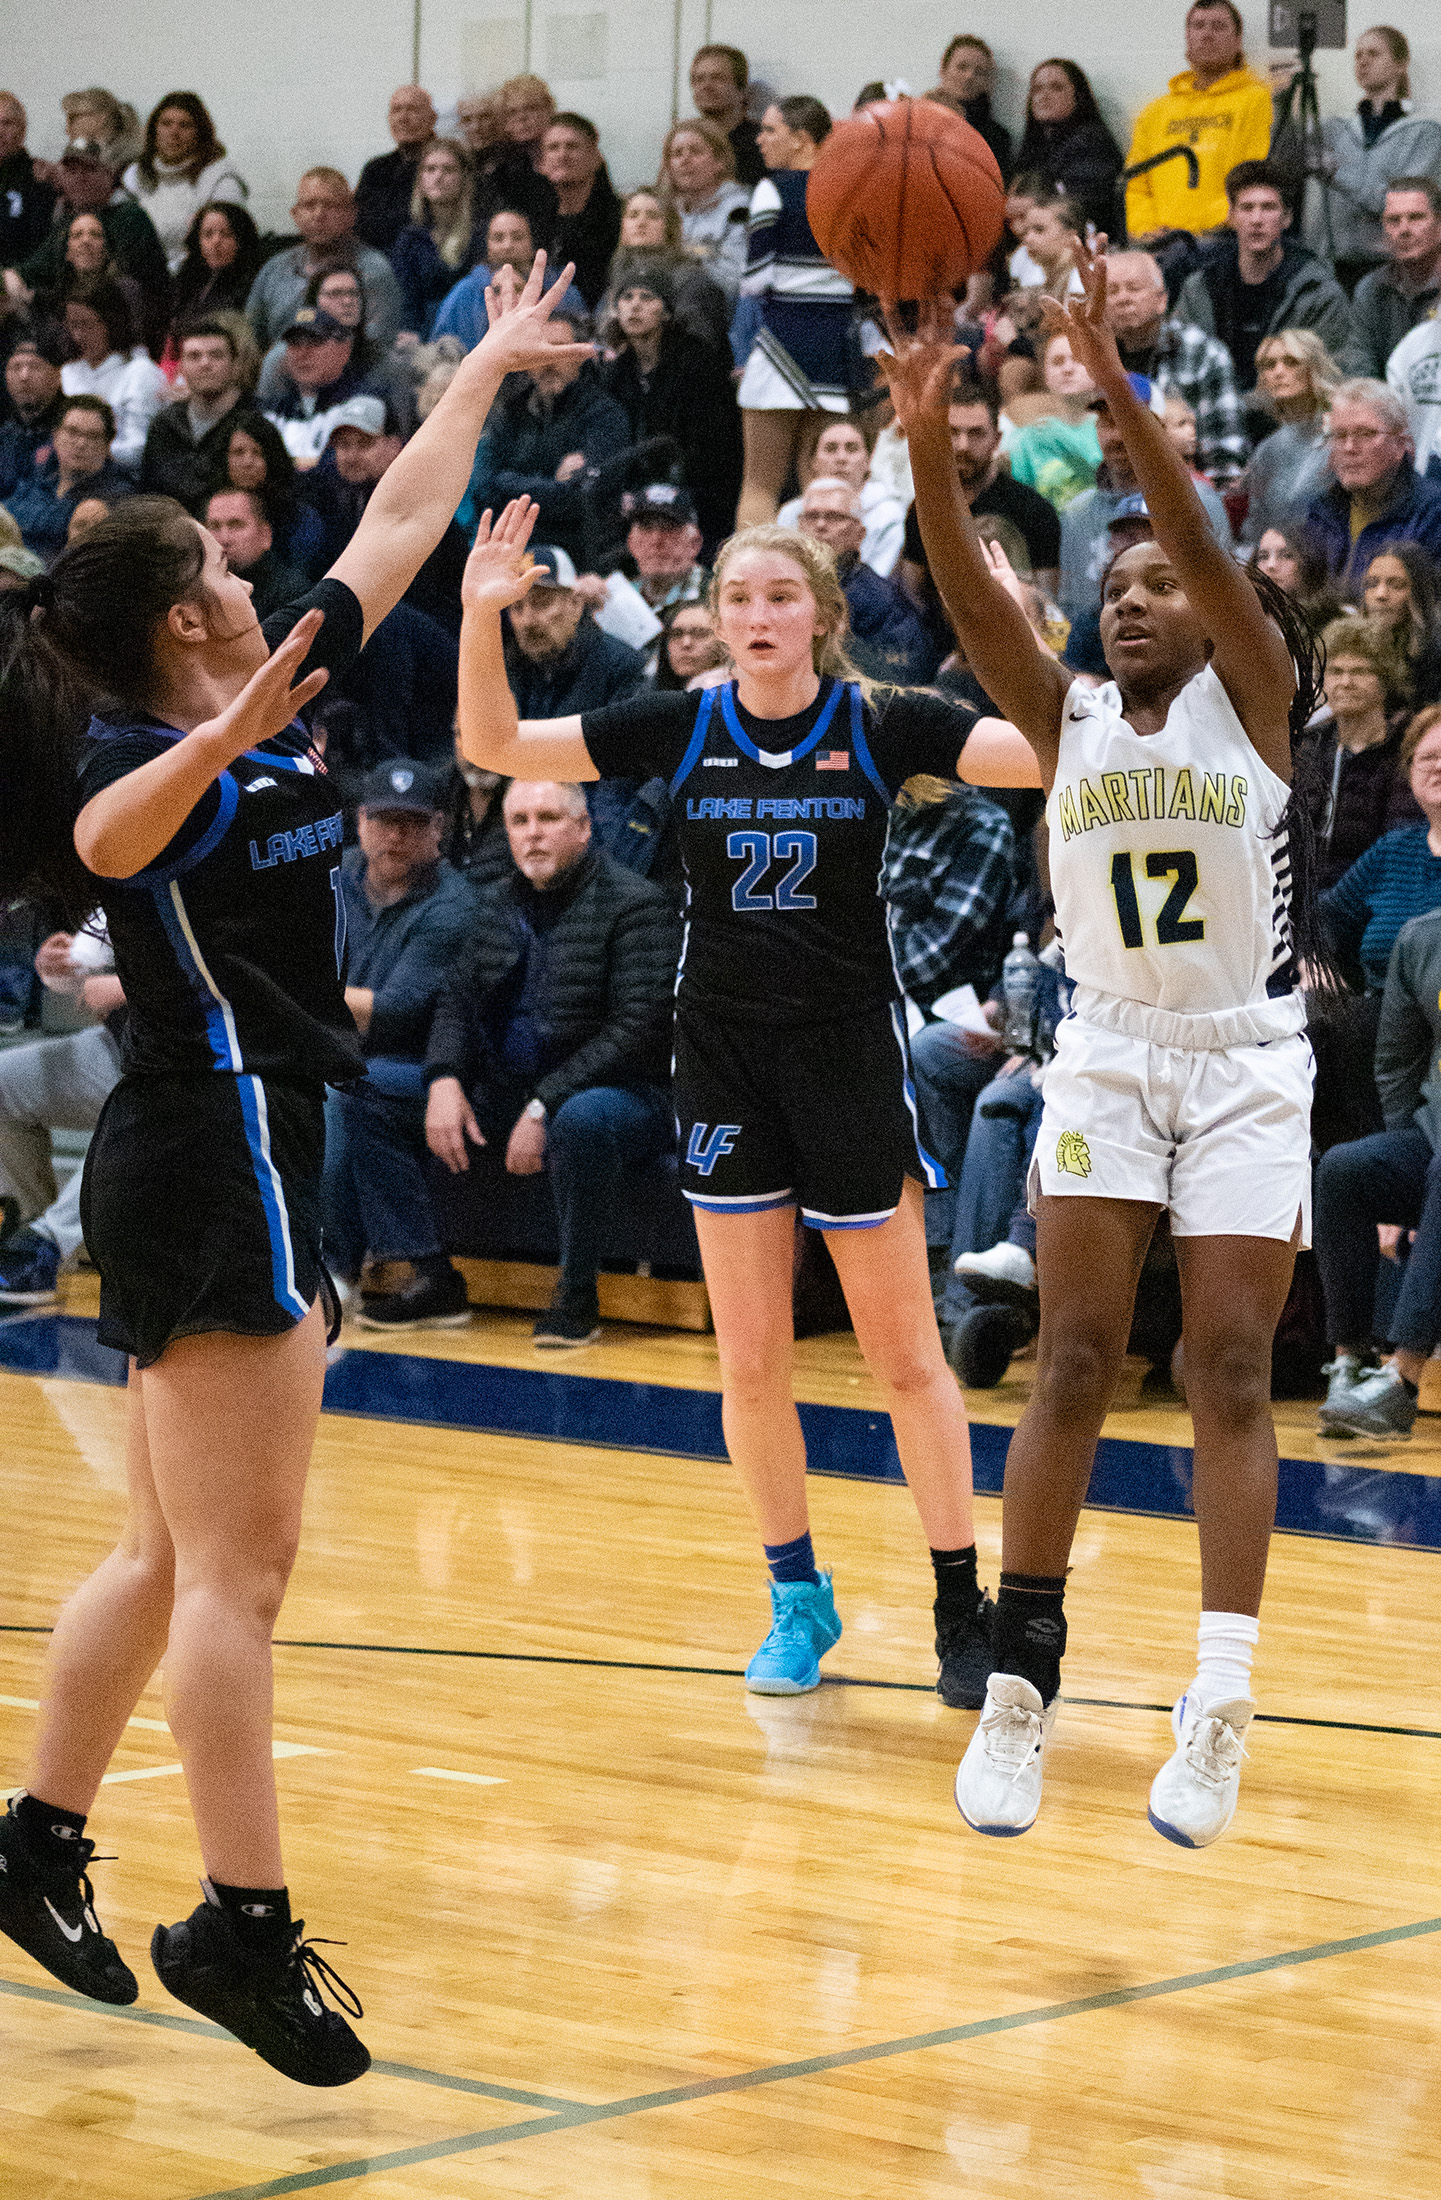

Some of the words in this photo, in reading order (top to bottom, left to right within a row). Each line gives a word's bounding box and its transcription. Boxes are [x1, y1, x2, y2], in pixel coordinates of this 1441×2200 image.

[686, 798, 752, 820] LAKE
[756, 798, 866, 820] FENTON
[1058, 767, 1248, 842] MARTIANS
[249, 824, 319, 871] LAKE
[727, 830, 818, 912] 22
[1110, 850, 1206, 949] 12
